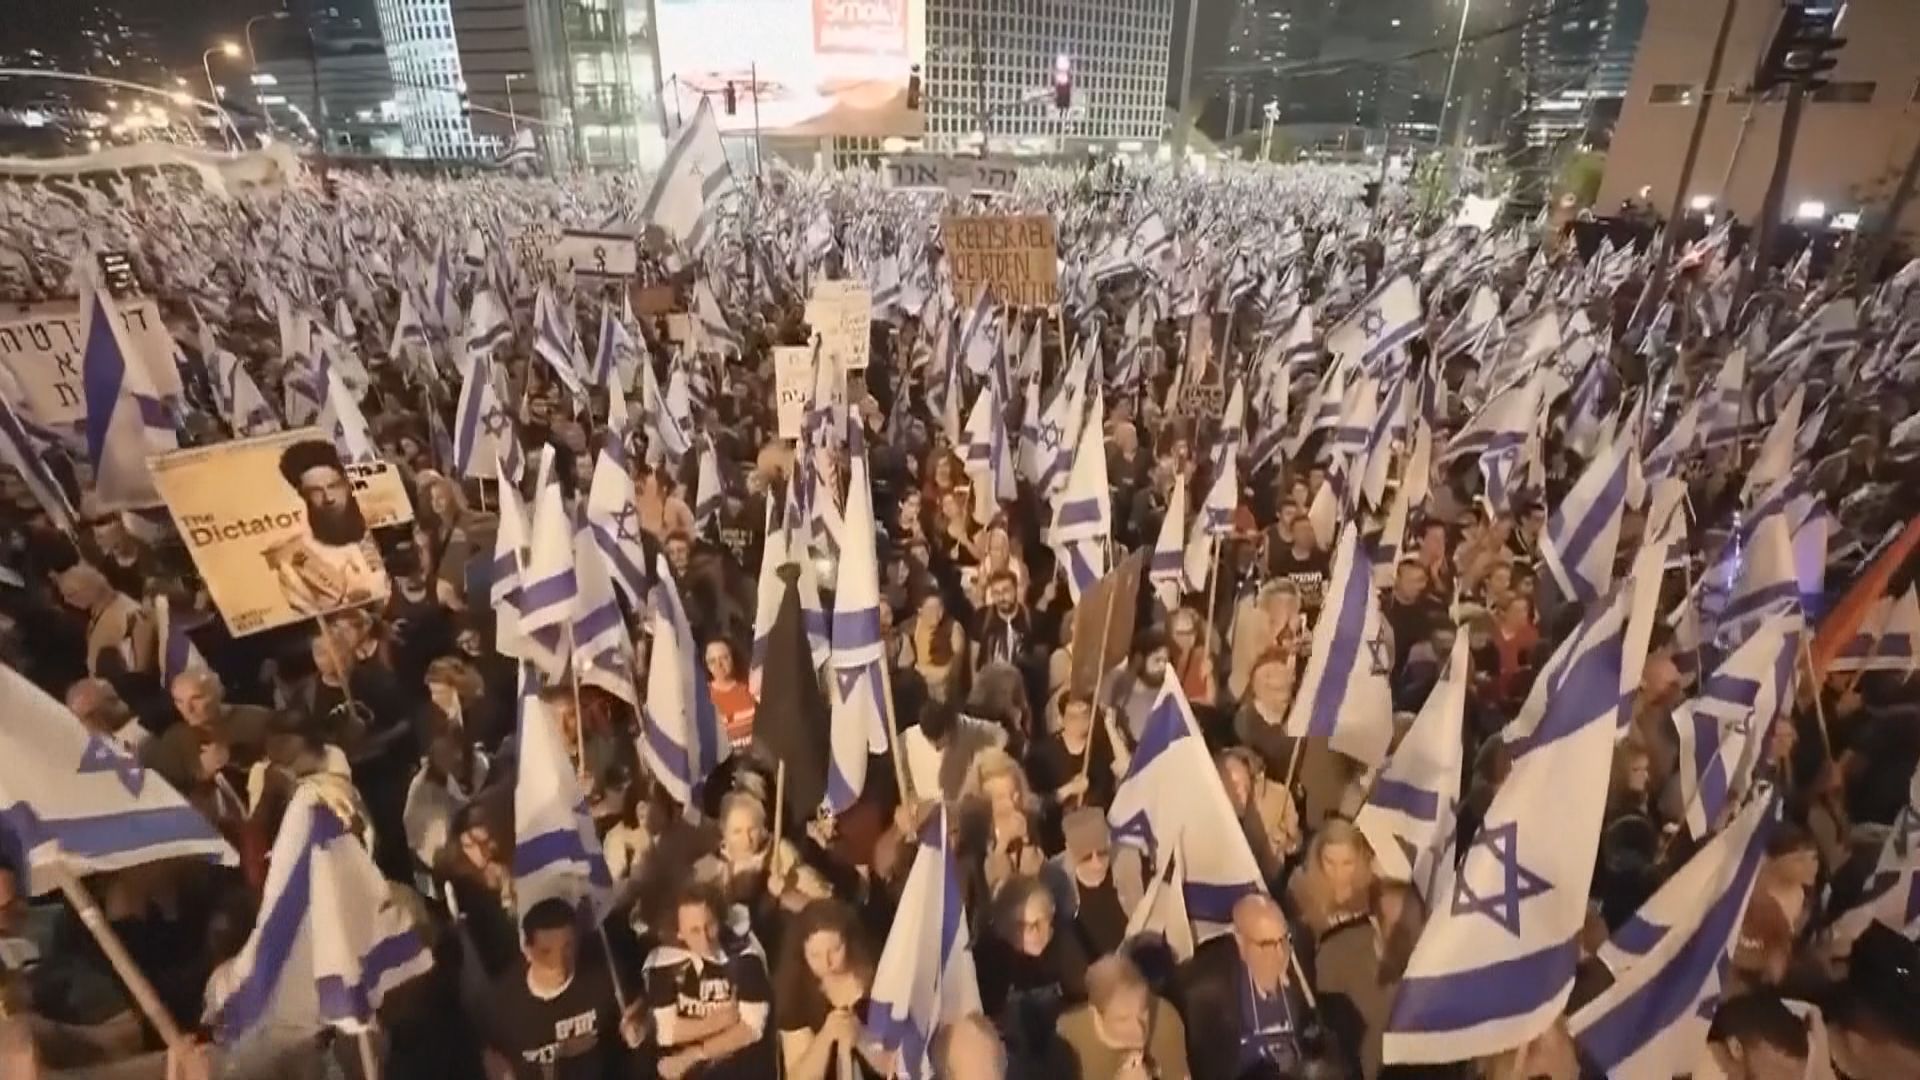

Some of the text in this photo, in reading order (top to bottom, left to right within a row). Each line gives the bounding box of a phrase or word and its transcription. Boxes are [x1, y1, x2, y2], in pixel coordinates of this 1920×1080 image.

[886, 163, 1018, 187] יהי אור
[0, 308, 147, 353] דרטיה
[181, 512, 214, 527] The
[189, 509, 302, 548] Dictator
